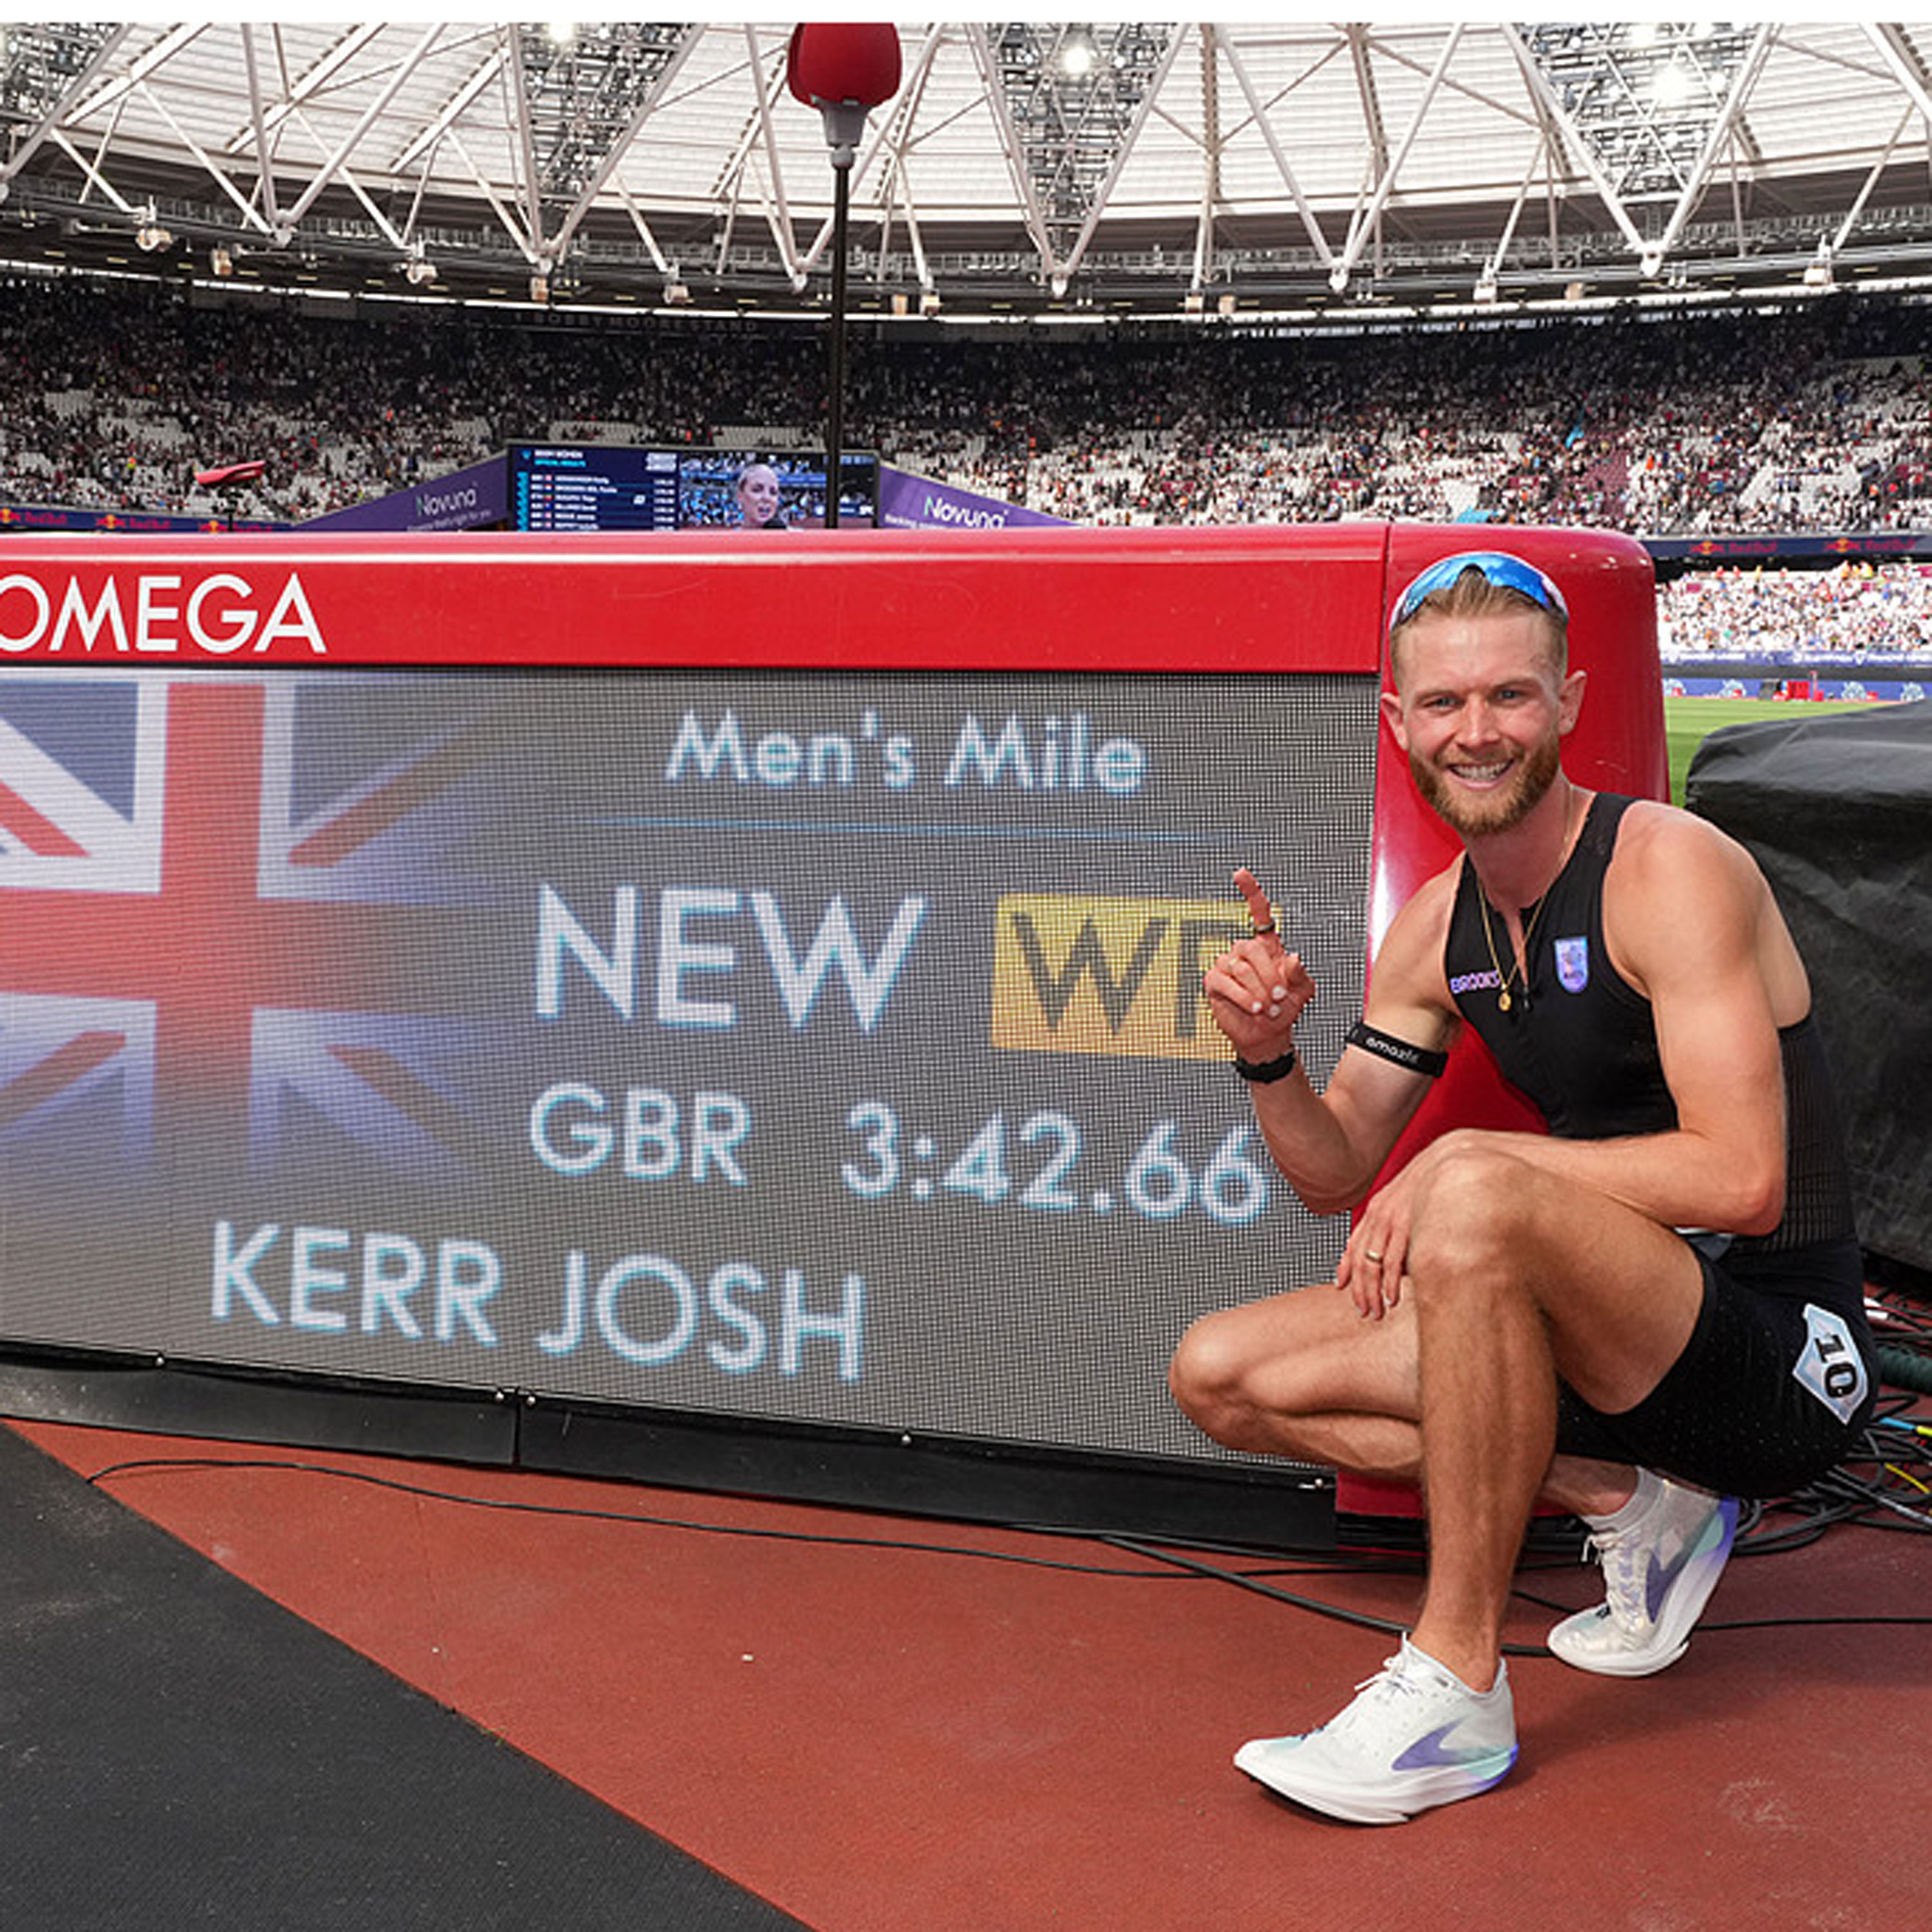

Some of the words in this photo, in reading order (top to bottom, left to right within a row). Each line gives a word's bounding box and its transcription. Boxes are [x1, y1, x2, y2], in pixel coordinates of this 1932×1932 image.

[415, 488, 478, 517] Novuna
[923, 495, 1005, 529] Novuna
[0, 573, 327, 654] OMEGA
[665, 708, 914, 789] Men's
[944, 710, 1148, 797] Mile
[533, 882, 929, 1034] NEW
[528, 1080, 752, 1187] GBR
[839, 1100, 1271, 1227] 3:42.66
[210, 1219, 501, 1347] KERR
[536, 1248, 867, 1381] JOSH
[1813, 1334, 1857, 1398] 10
